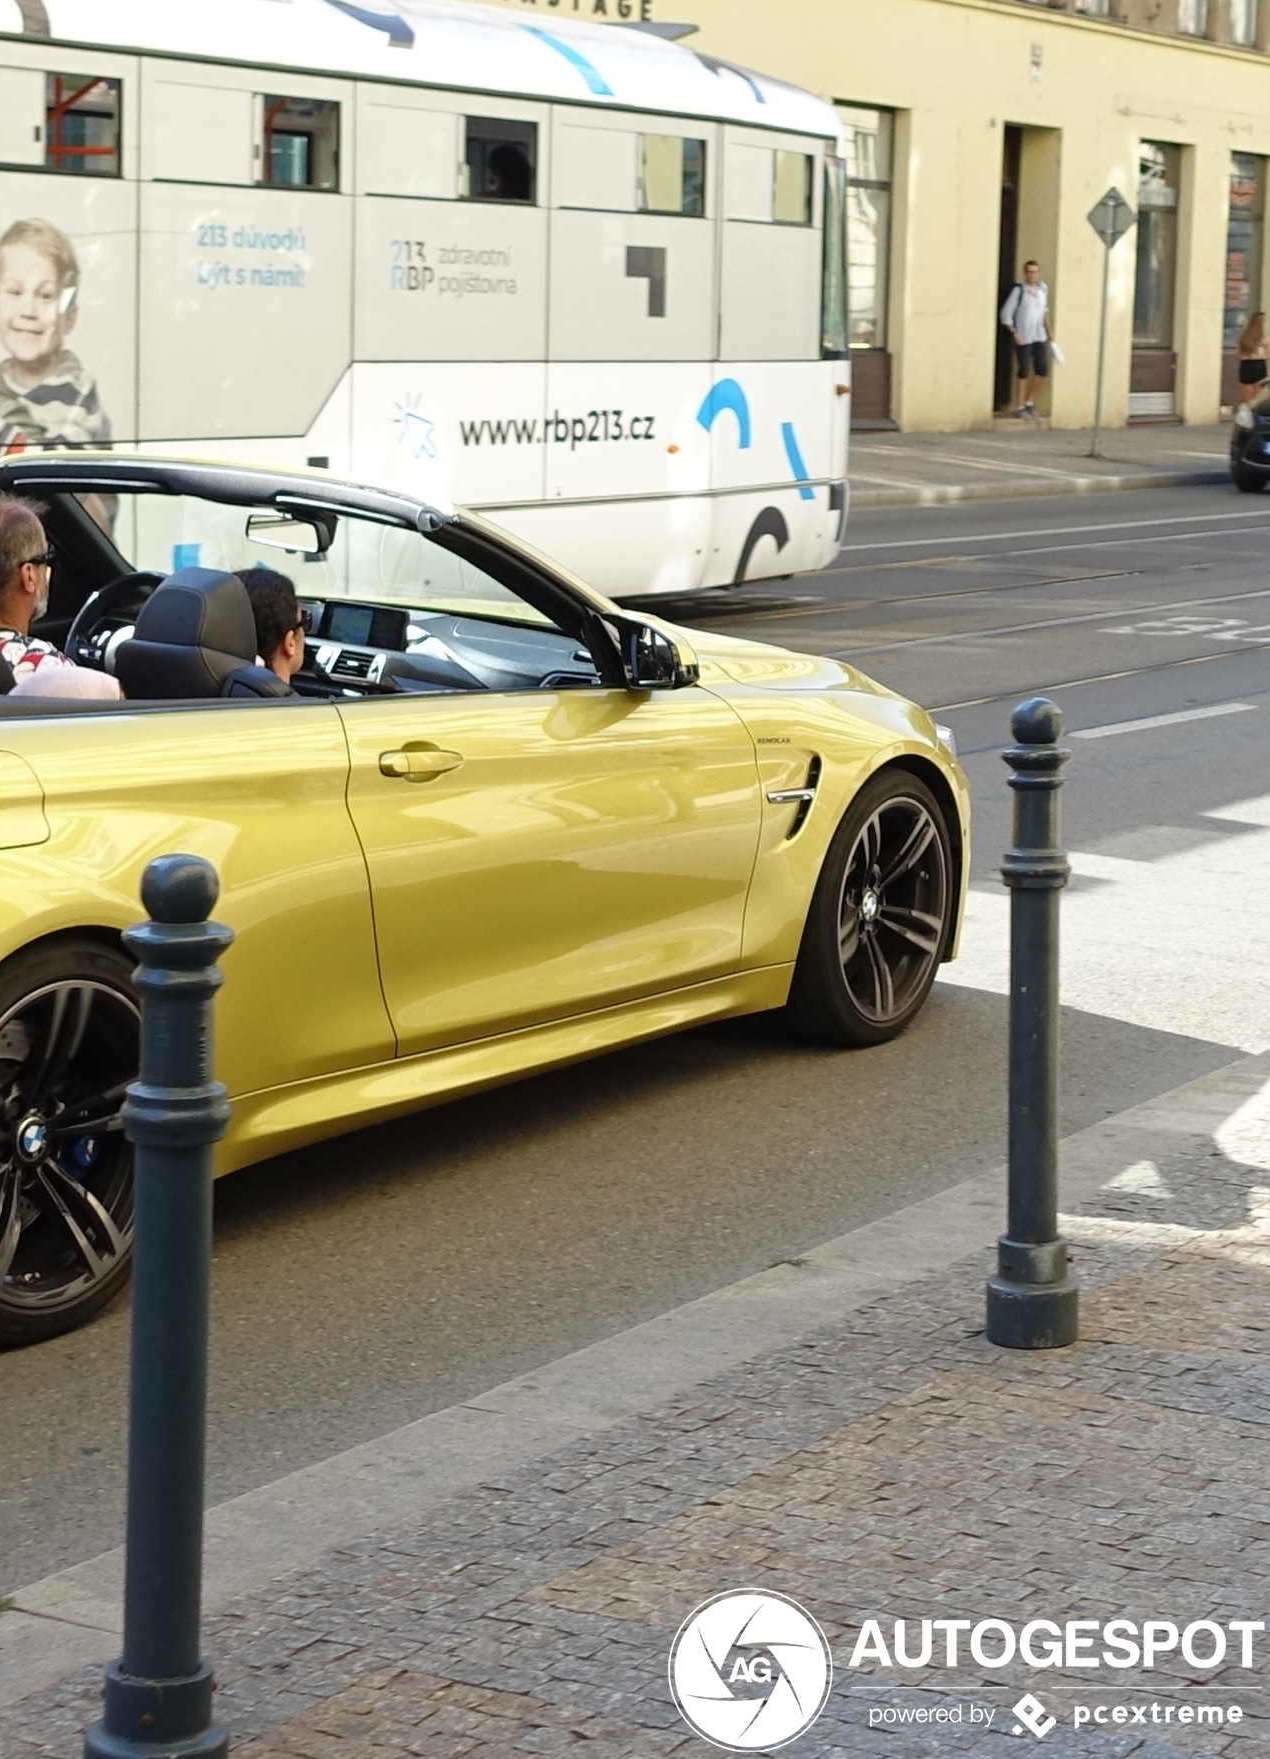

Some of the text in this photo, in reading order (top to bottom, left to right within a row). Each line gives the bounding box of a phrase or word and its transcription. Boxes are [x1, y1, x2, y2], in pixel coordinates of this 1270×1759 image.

[197, 224, 228, 247] 213
[391, 239, 427, 262] 213
[235, 267, 245, 285] s
[391, 264, 435, 291] RBP
[460, 408, 655, 451] www.rbp213.cz
